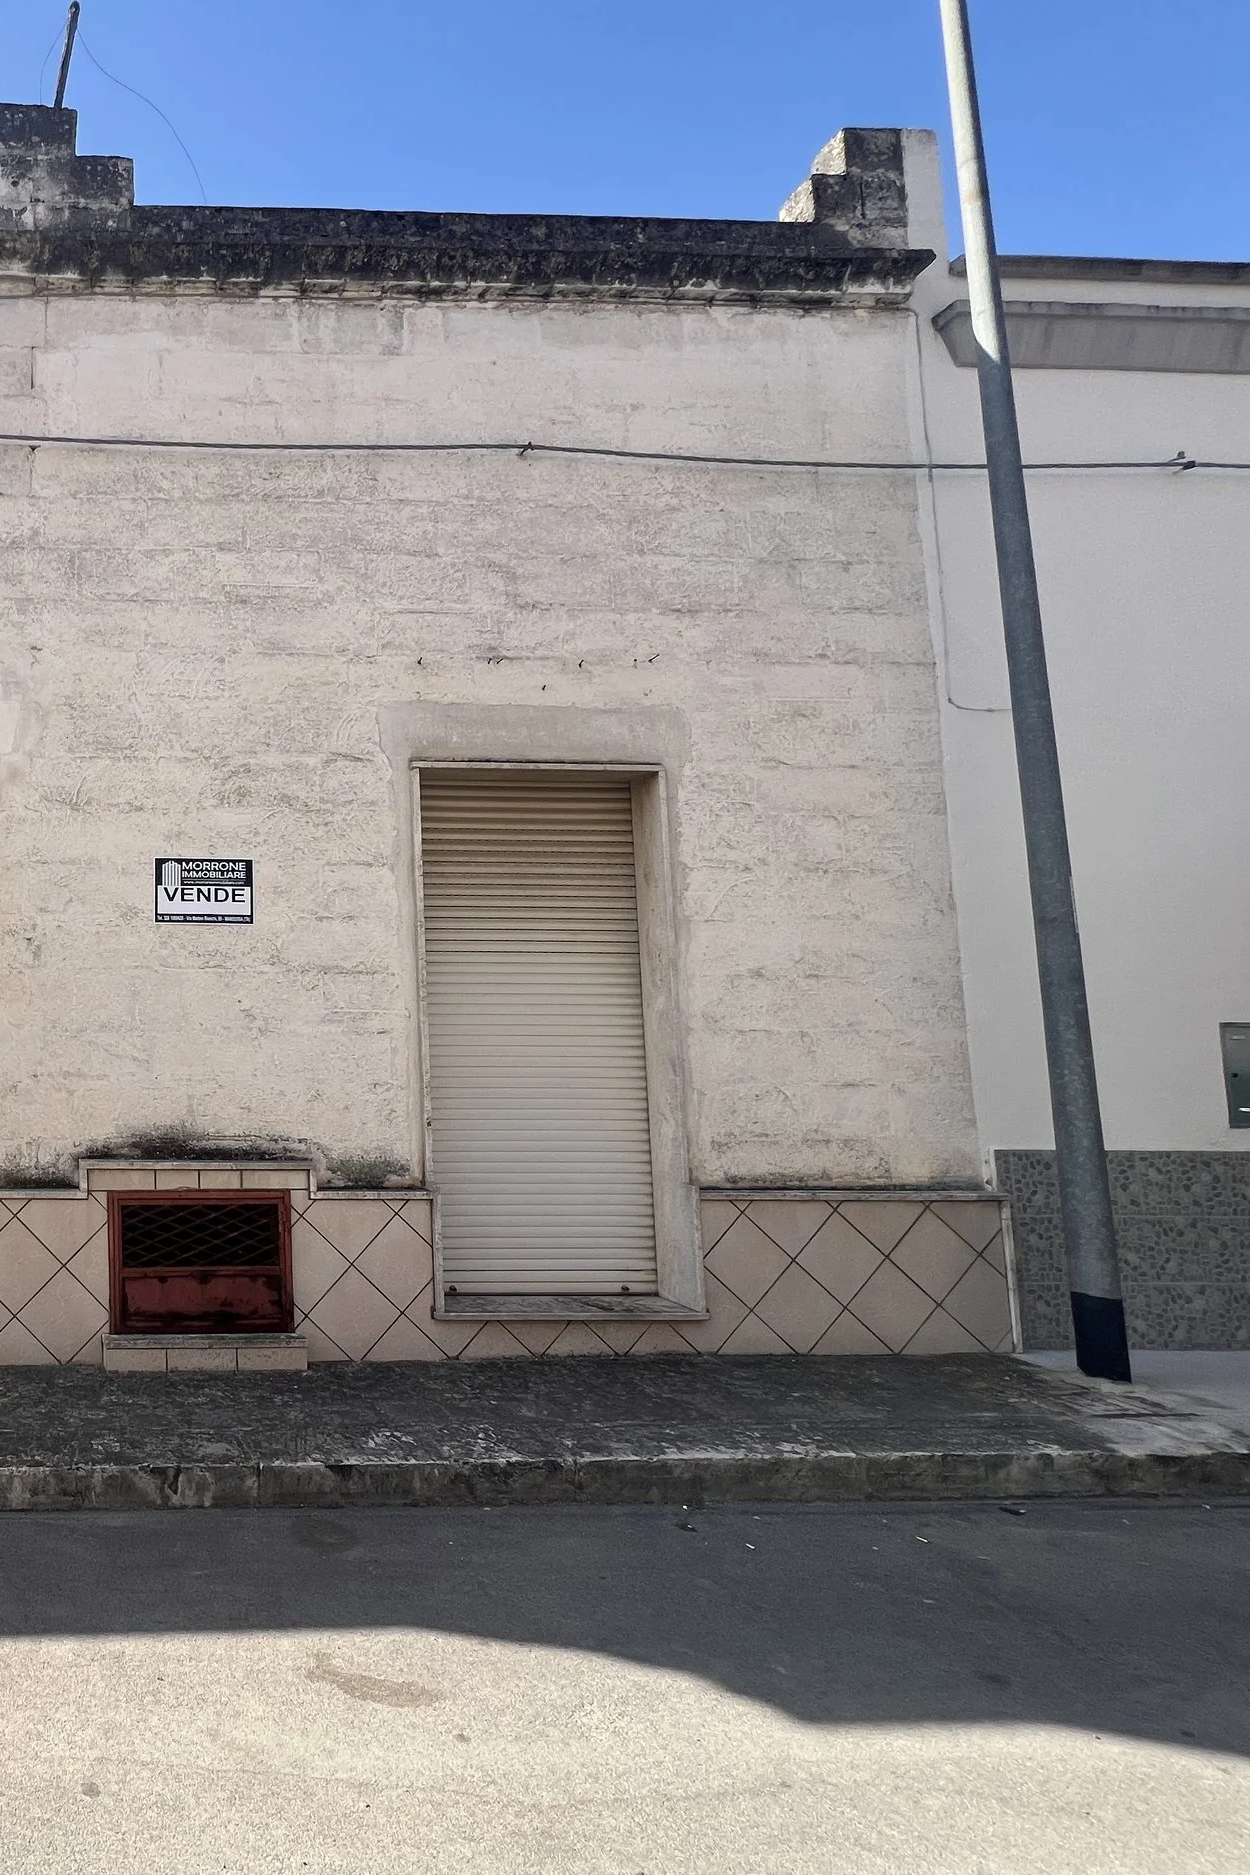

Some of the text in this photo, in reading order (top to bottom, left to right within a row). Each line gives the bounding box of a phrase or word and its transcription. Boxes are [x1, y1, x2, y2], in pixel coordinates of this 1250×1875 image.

[181, 861, 247, 871] MORRONE
[181, 871, 247, 879] IMMOBILIARE
[163, 887, 246, 903] VENDE
